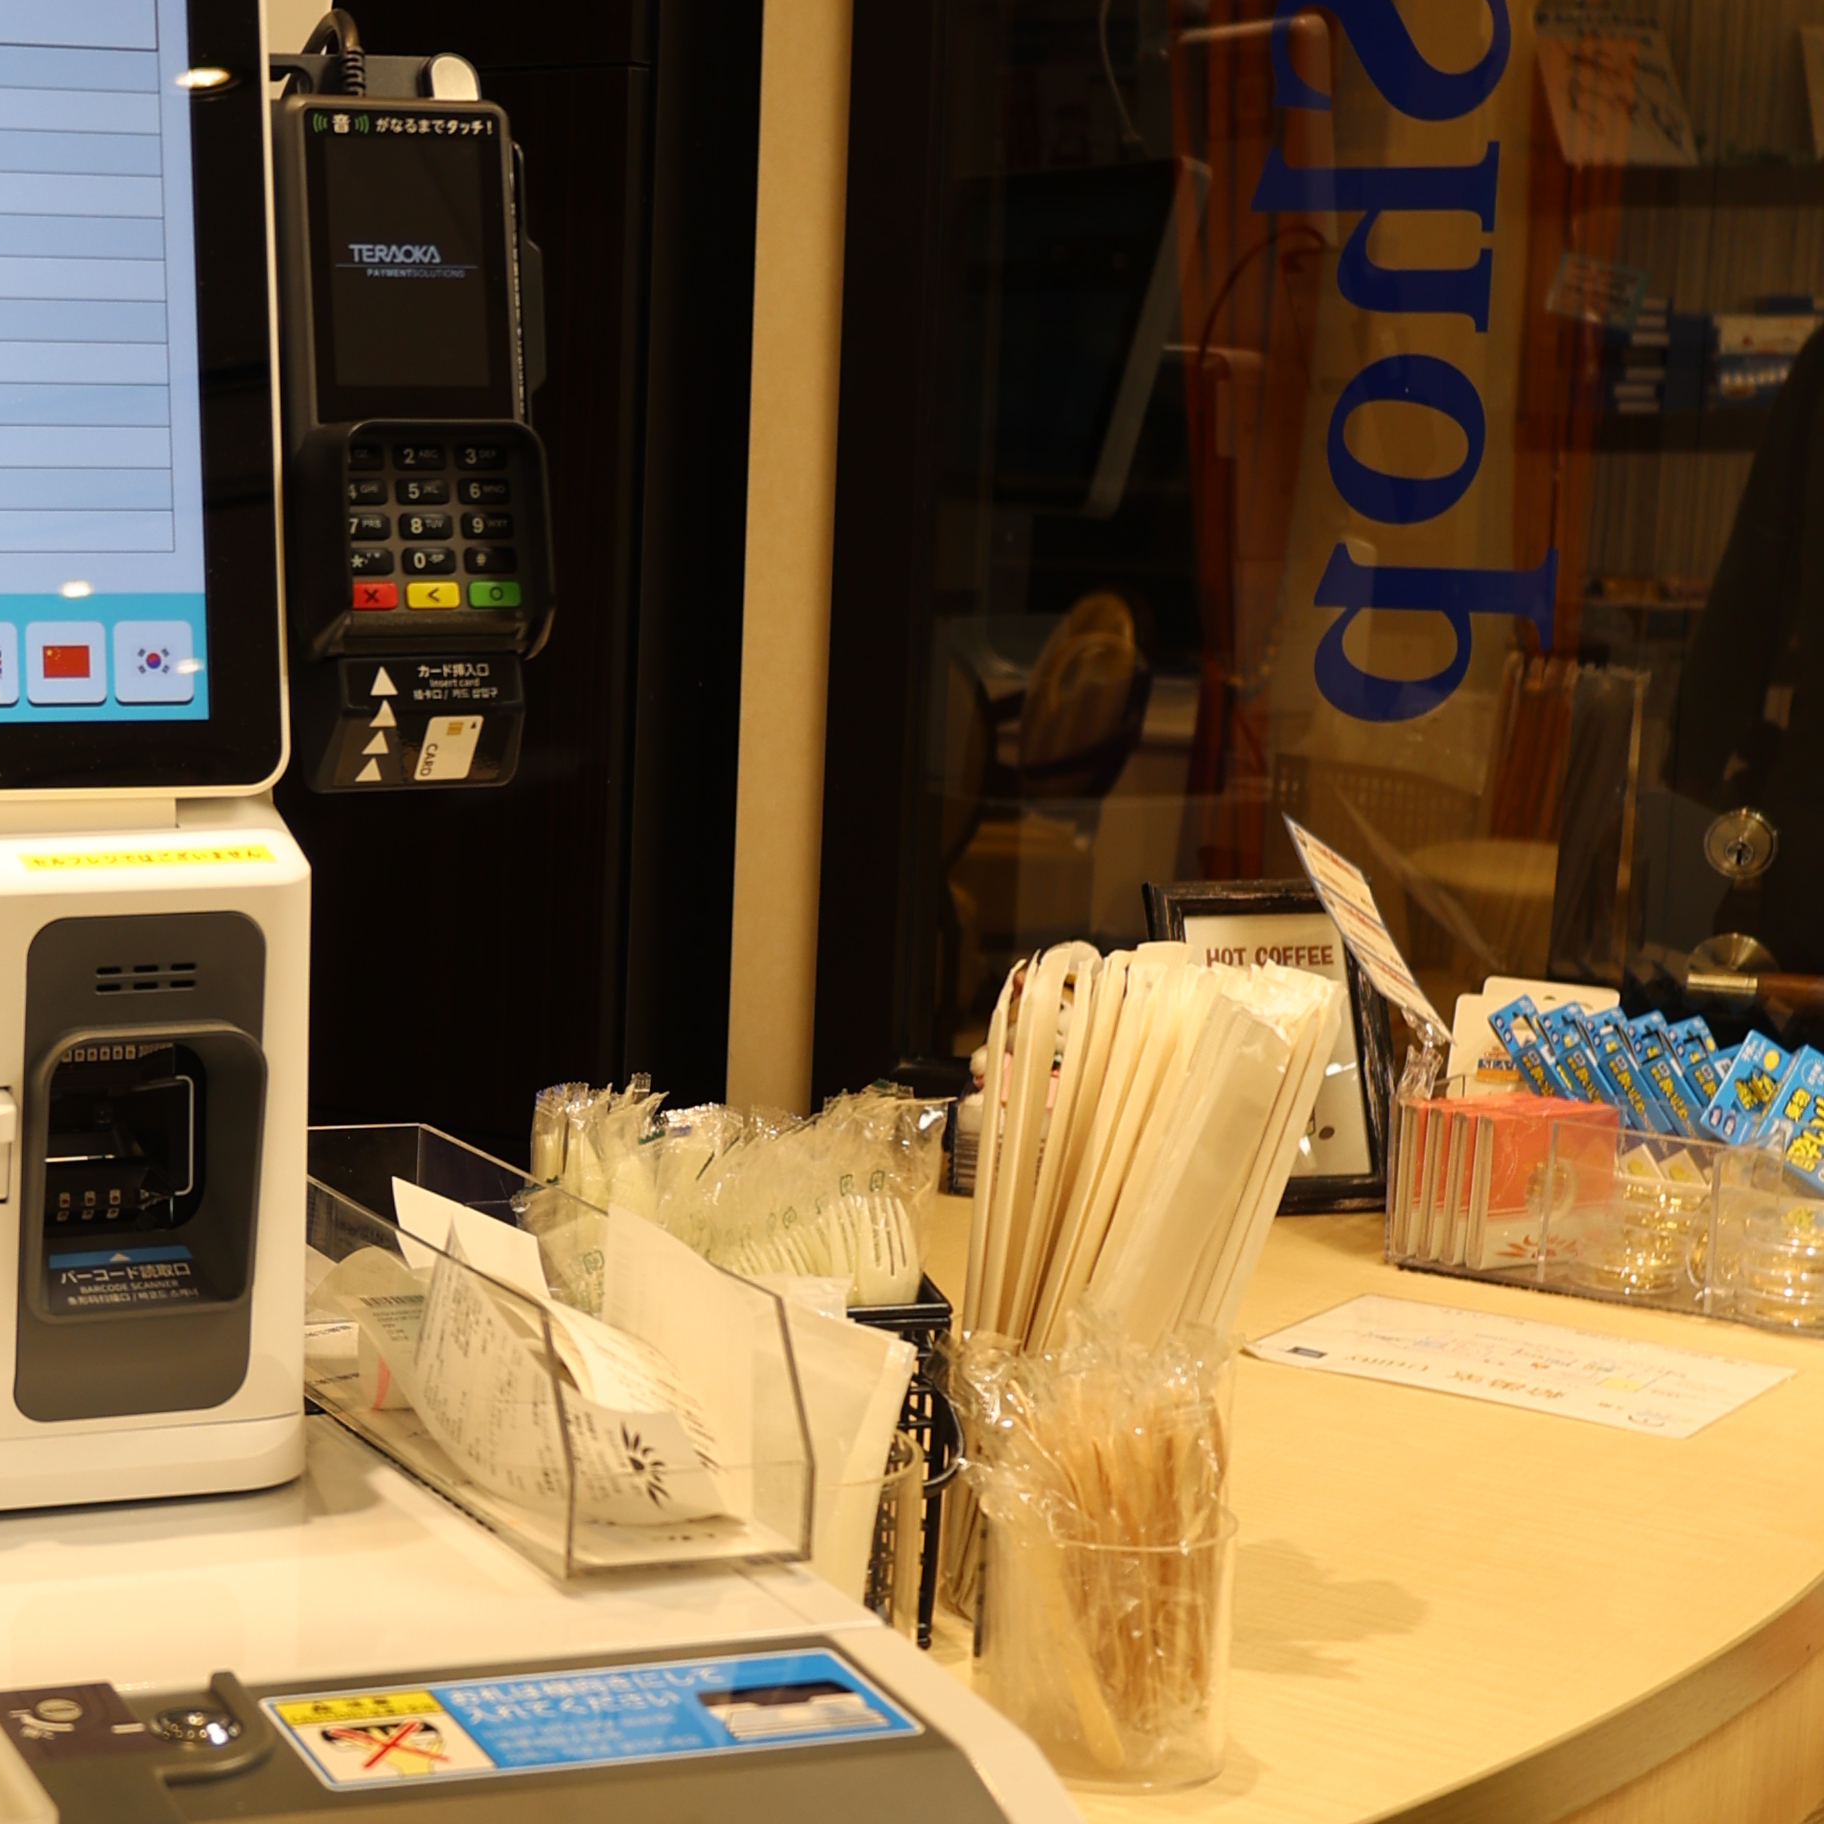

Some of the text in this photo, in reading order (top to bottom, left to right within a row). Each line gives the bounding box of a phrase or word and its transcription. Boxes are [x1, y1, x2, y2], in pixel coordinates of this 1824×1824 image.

[332, 113, 350, 134] 音
[348, 244, 441, 263] TERAOKA
[403, 448, 415, 464] 2
[465, 448, 476, 464] 3
[408, 483, 420, 499] 5
[469, 483, 481, 498] 6
[349, 518, 359, 534] 7
[410, 518, 423, 534] 8
[472, 518, 484, 533] 9
[413, 552, 426, 568] 0
[420, 743, 438, 777] CARD
[1206, 945, 1334, 967] HOT COFFEE
[80, 1282, 128, 1294] BARCODE
